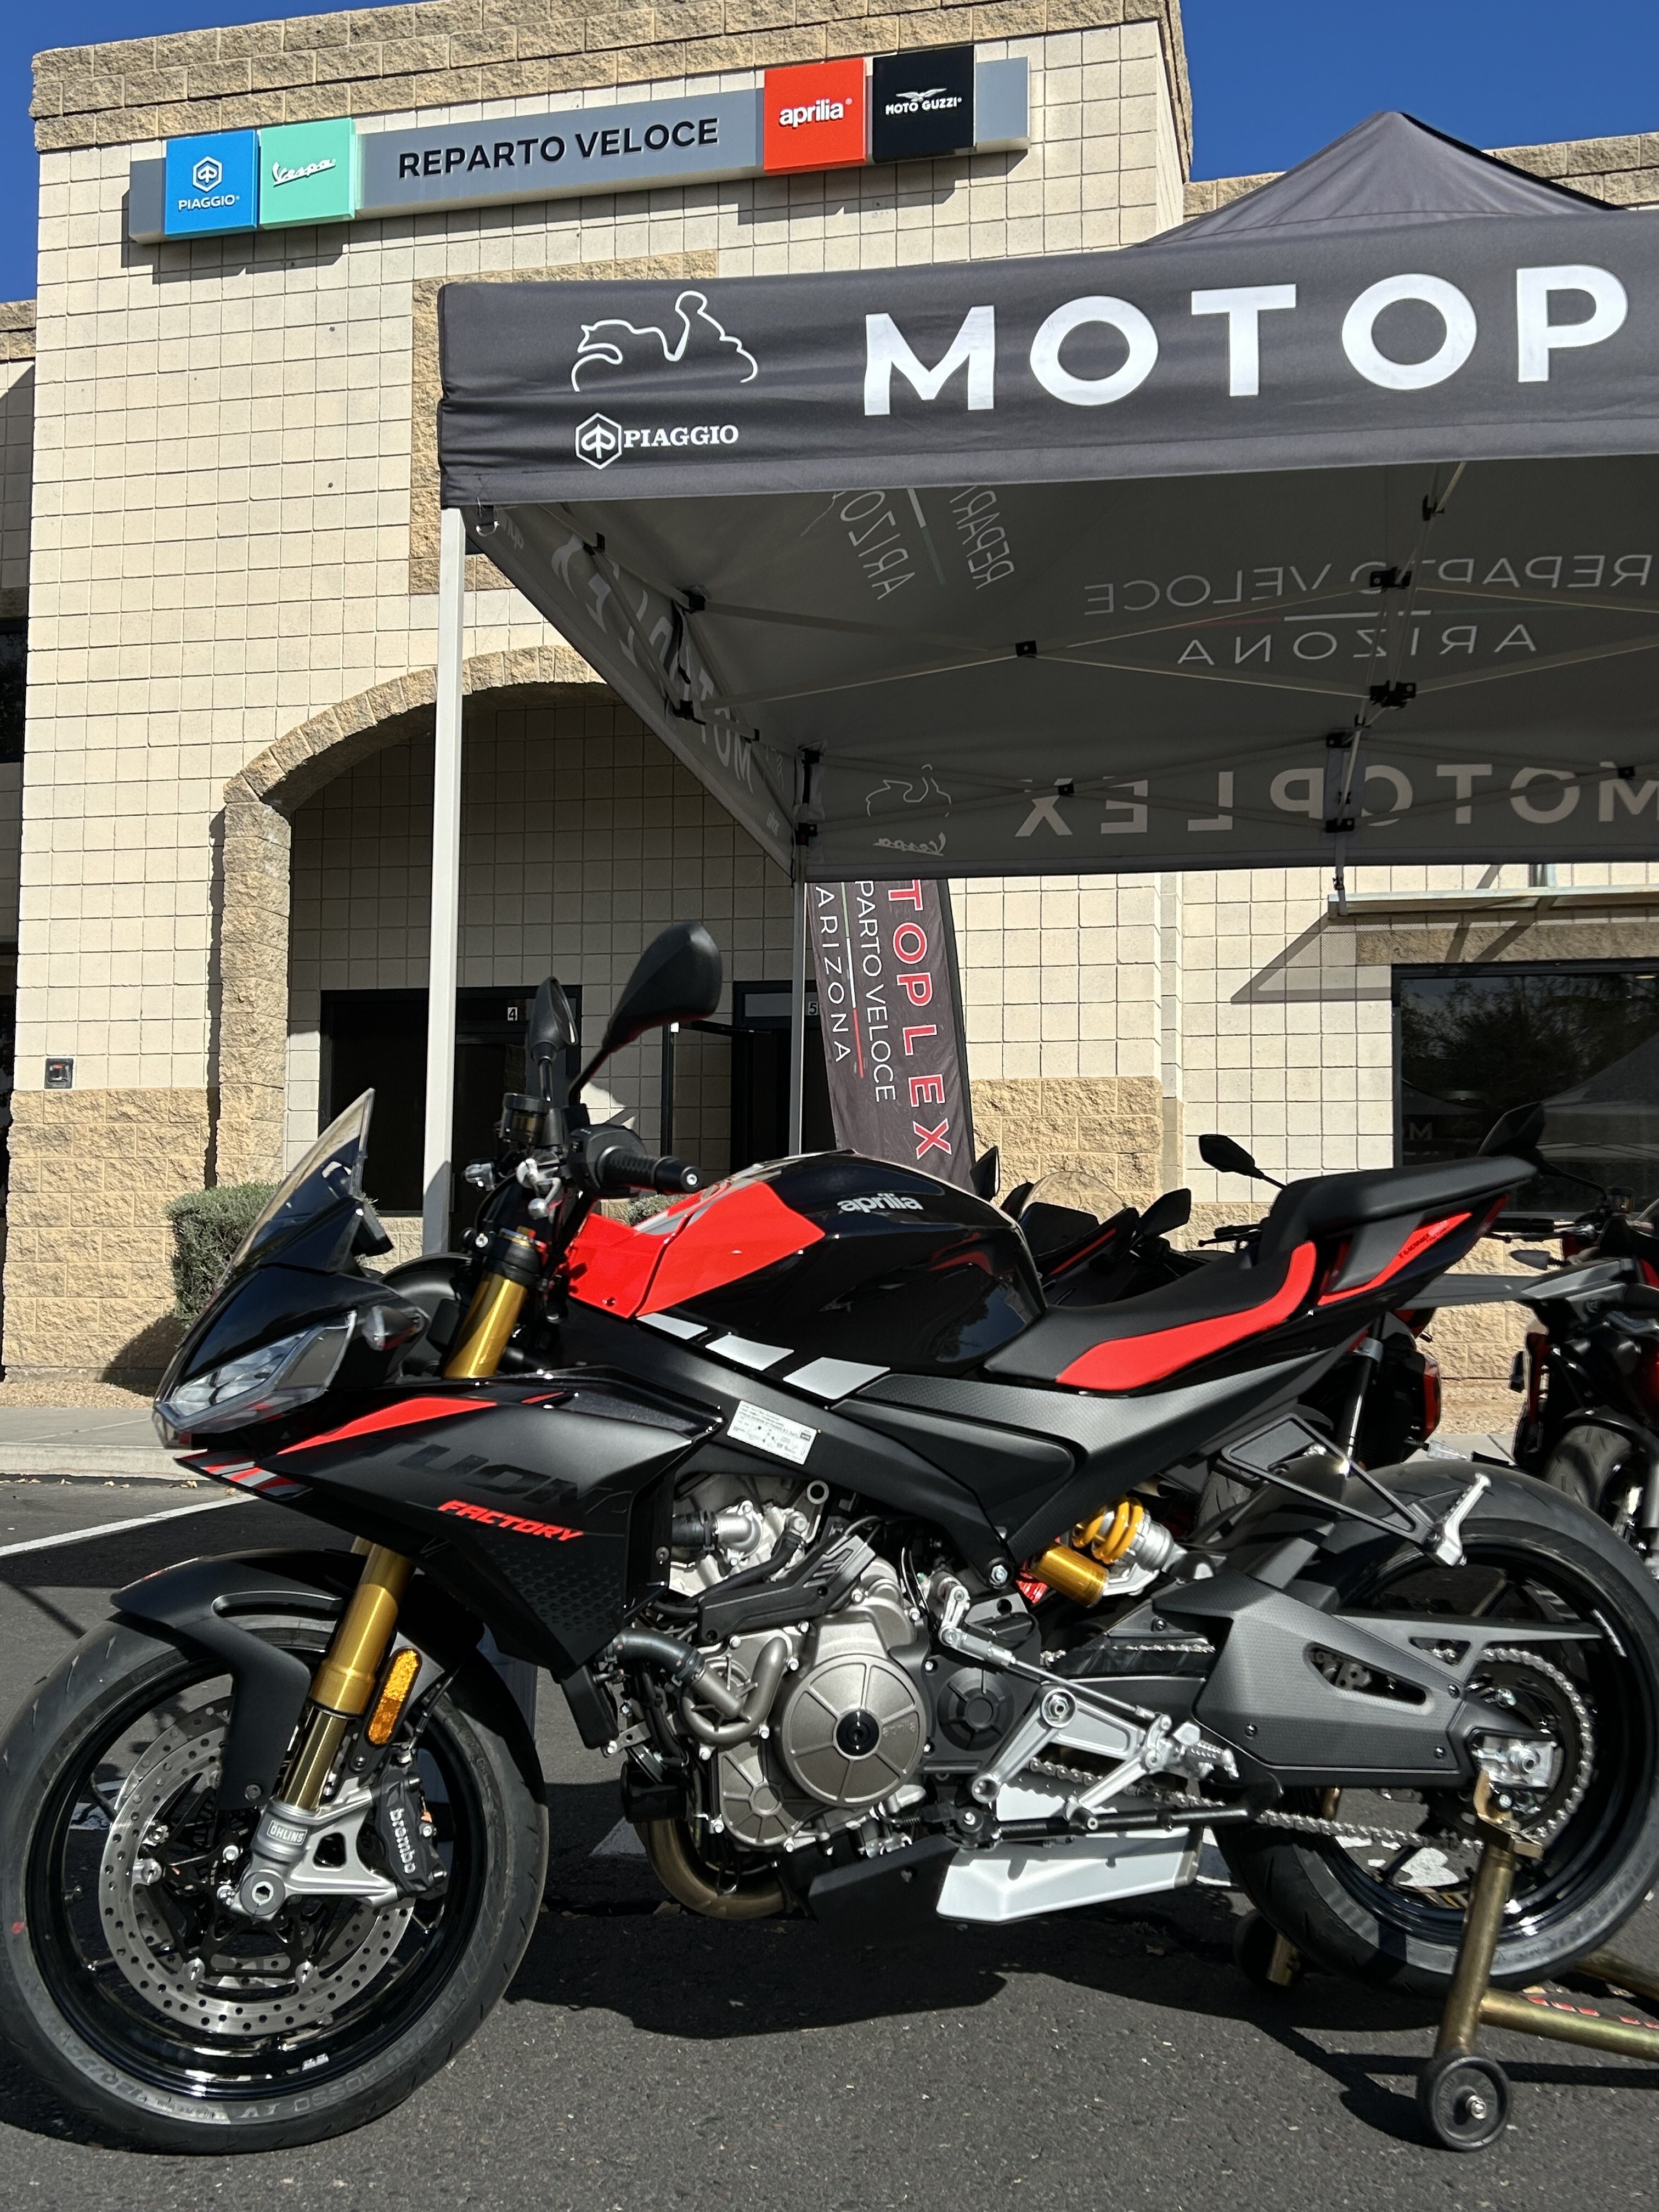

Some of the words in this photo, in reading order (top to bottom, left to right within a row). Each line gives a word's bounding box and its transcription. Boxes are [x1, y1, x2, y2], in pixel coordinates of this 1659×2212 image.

[779, 99, 844, 128] aprilia
[885, 101, 918, 115] MOTO
[922, 97, 957, 110] GUZZI
[399, 136, 565, 178] REPARTO
[575, 118, 718, 158] VELOCE
[272, 159, 336, 187] Vespa
[178, 194, 235, 211] PIAGGIO
[623, 424, 739, 449] PIAGGIO
[854, 880, 883, 978] PARTO
[815, 885, 851, 1063] ARIZONA
[508, 1008, 517, 1021] 4
[809, 1002, 817, 1014] 5
[888, 879, 952, 1160] TOPLEX
[865, 984, 896, 1103] VELOCE
[837, 1193, 924, 1214] aprilia
[437, 1499, 585, 1542] FACTORY
[390, 1808, 416, 1875] brembo
